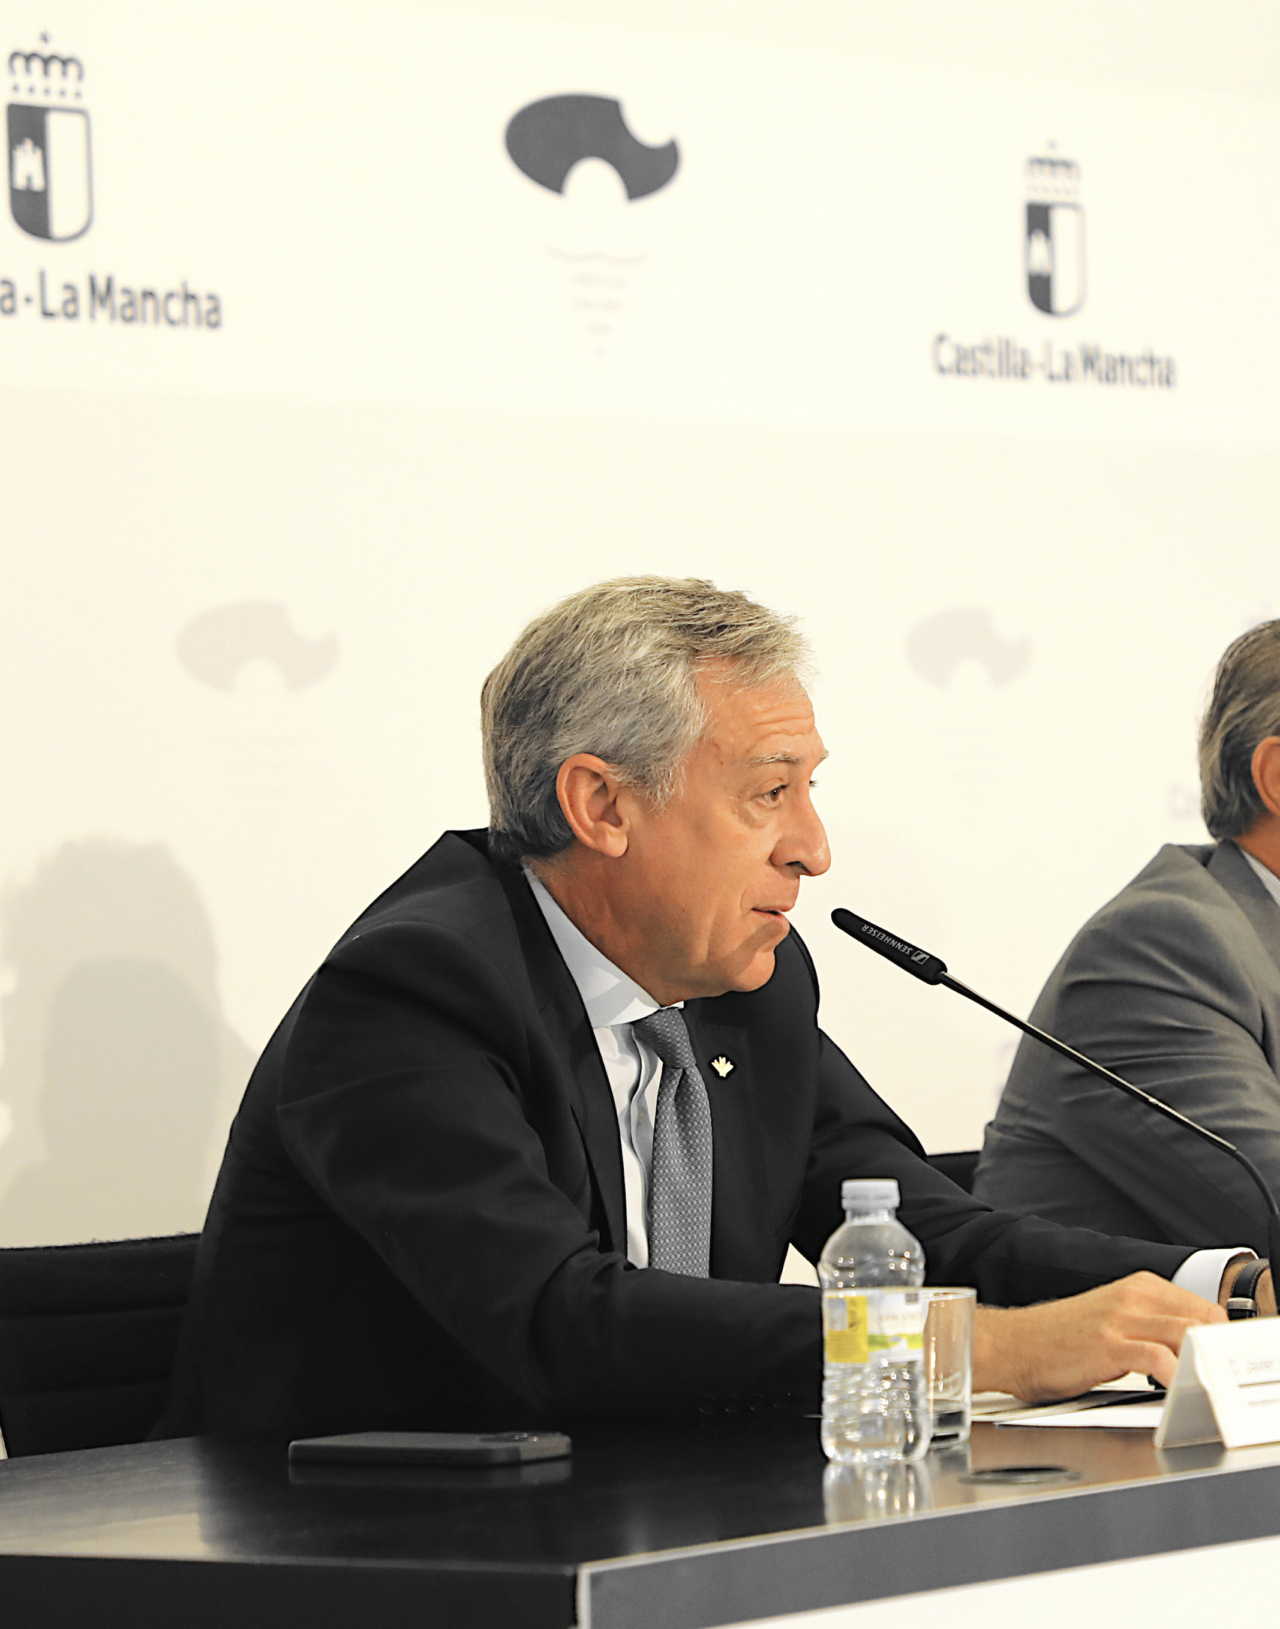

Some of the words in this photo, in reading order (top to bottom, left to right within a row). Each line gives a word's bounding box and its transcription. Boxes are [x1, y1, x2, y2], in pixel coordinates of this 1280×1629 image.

[88, 273, 222, 330] Mancha
[1079, 339, 1177, 389] Mancha
[861, 923, 914, 955] SENNHEISER
